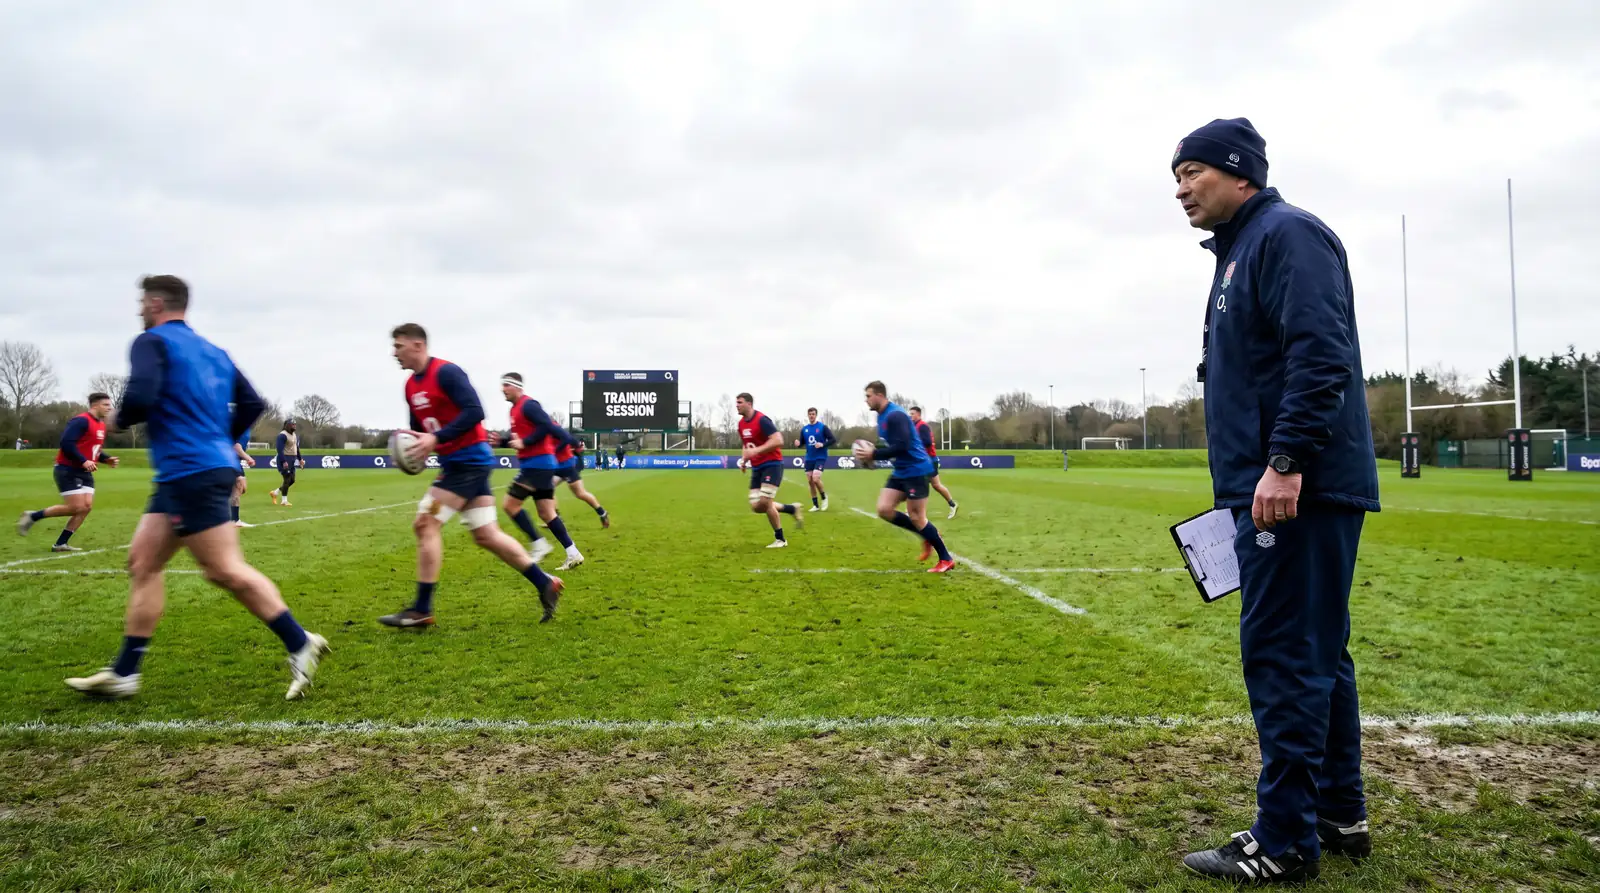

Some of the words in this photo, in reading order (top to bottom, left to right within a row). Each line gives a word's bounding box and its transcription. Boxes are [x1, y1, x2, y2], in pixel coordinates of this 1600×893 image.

[1216, 294, 1227, 313] O2
[603, 391, 658, 404] TRAINING
[605, 404, 655, 417] SESSION
[374, 456, 386, 468] O2
